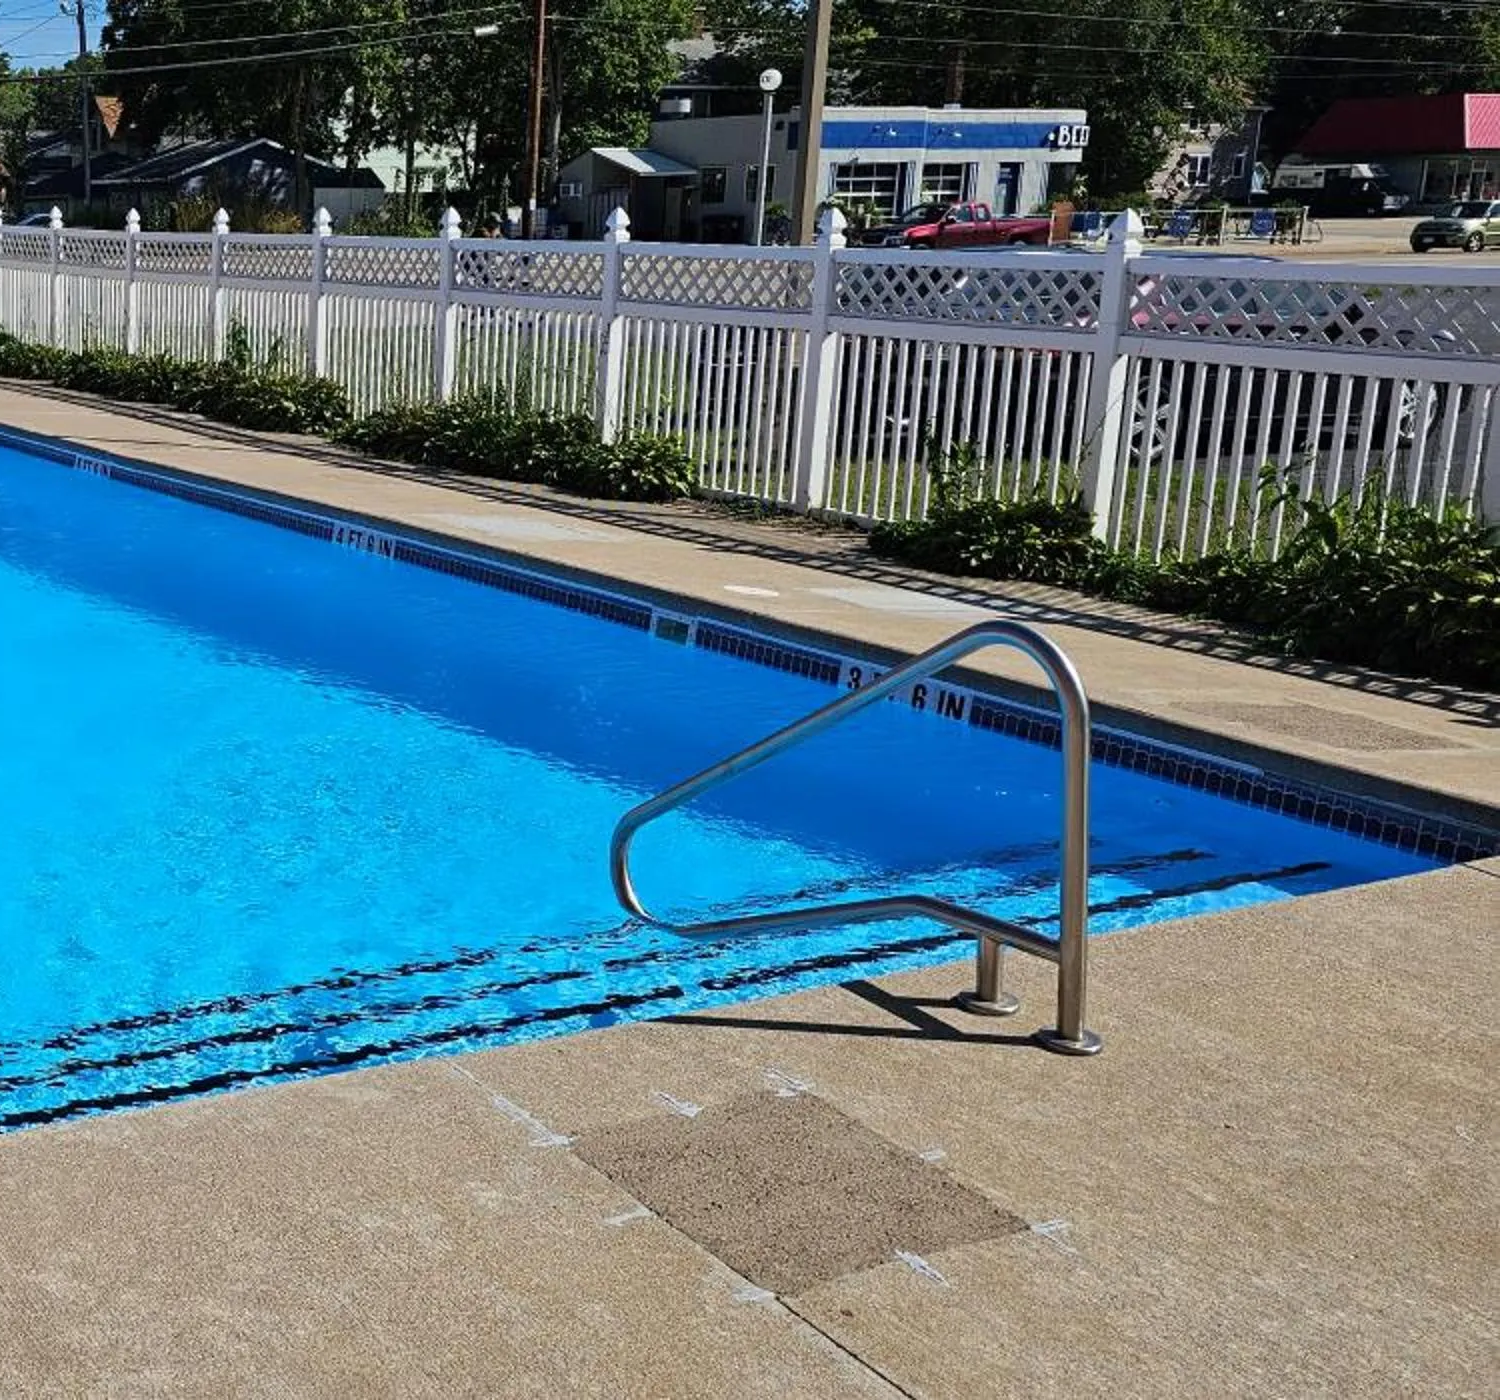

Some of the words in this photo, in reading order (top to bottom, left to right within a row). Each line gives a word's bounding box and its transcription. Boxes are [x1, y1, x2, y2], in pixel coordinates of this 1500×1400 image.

[348, 529, 362, 549] FT
[847, 666, 861, 690] 3
[911, 683, 927, 710] 6
[936, 689, 965, 720] IN
